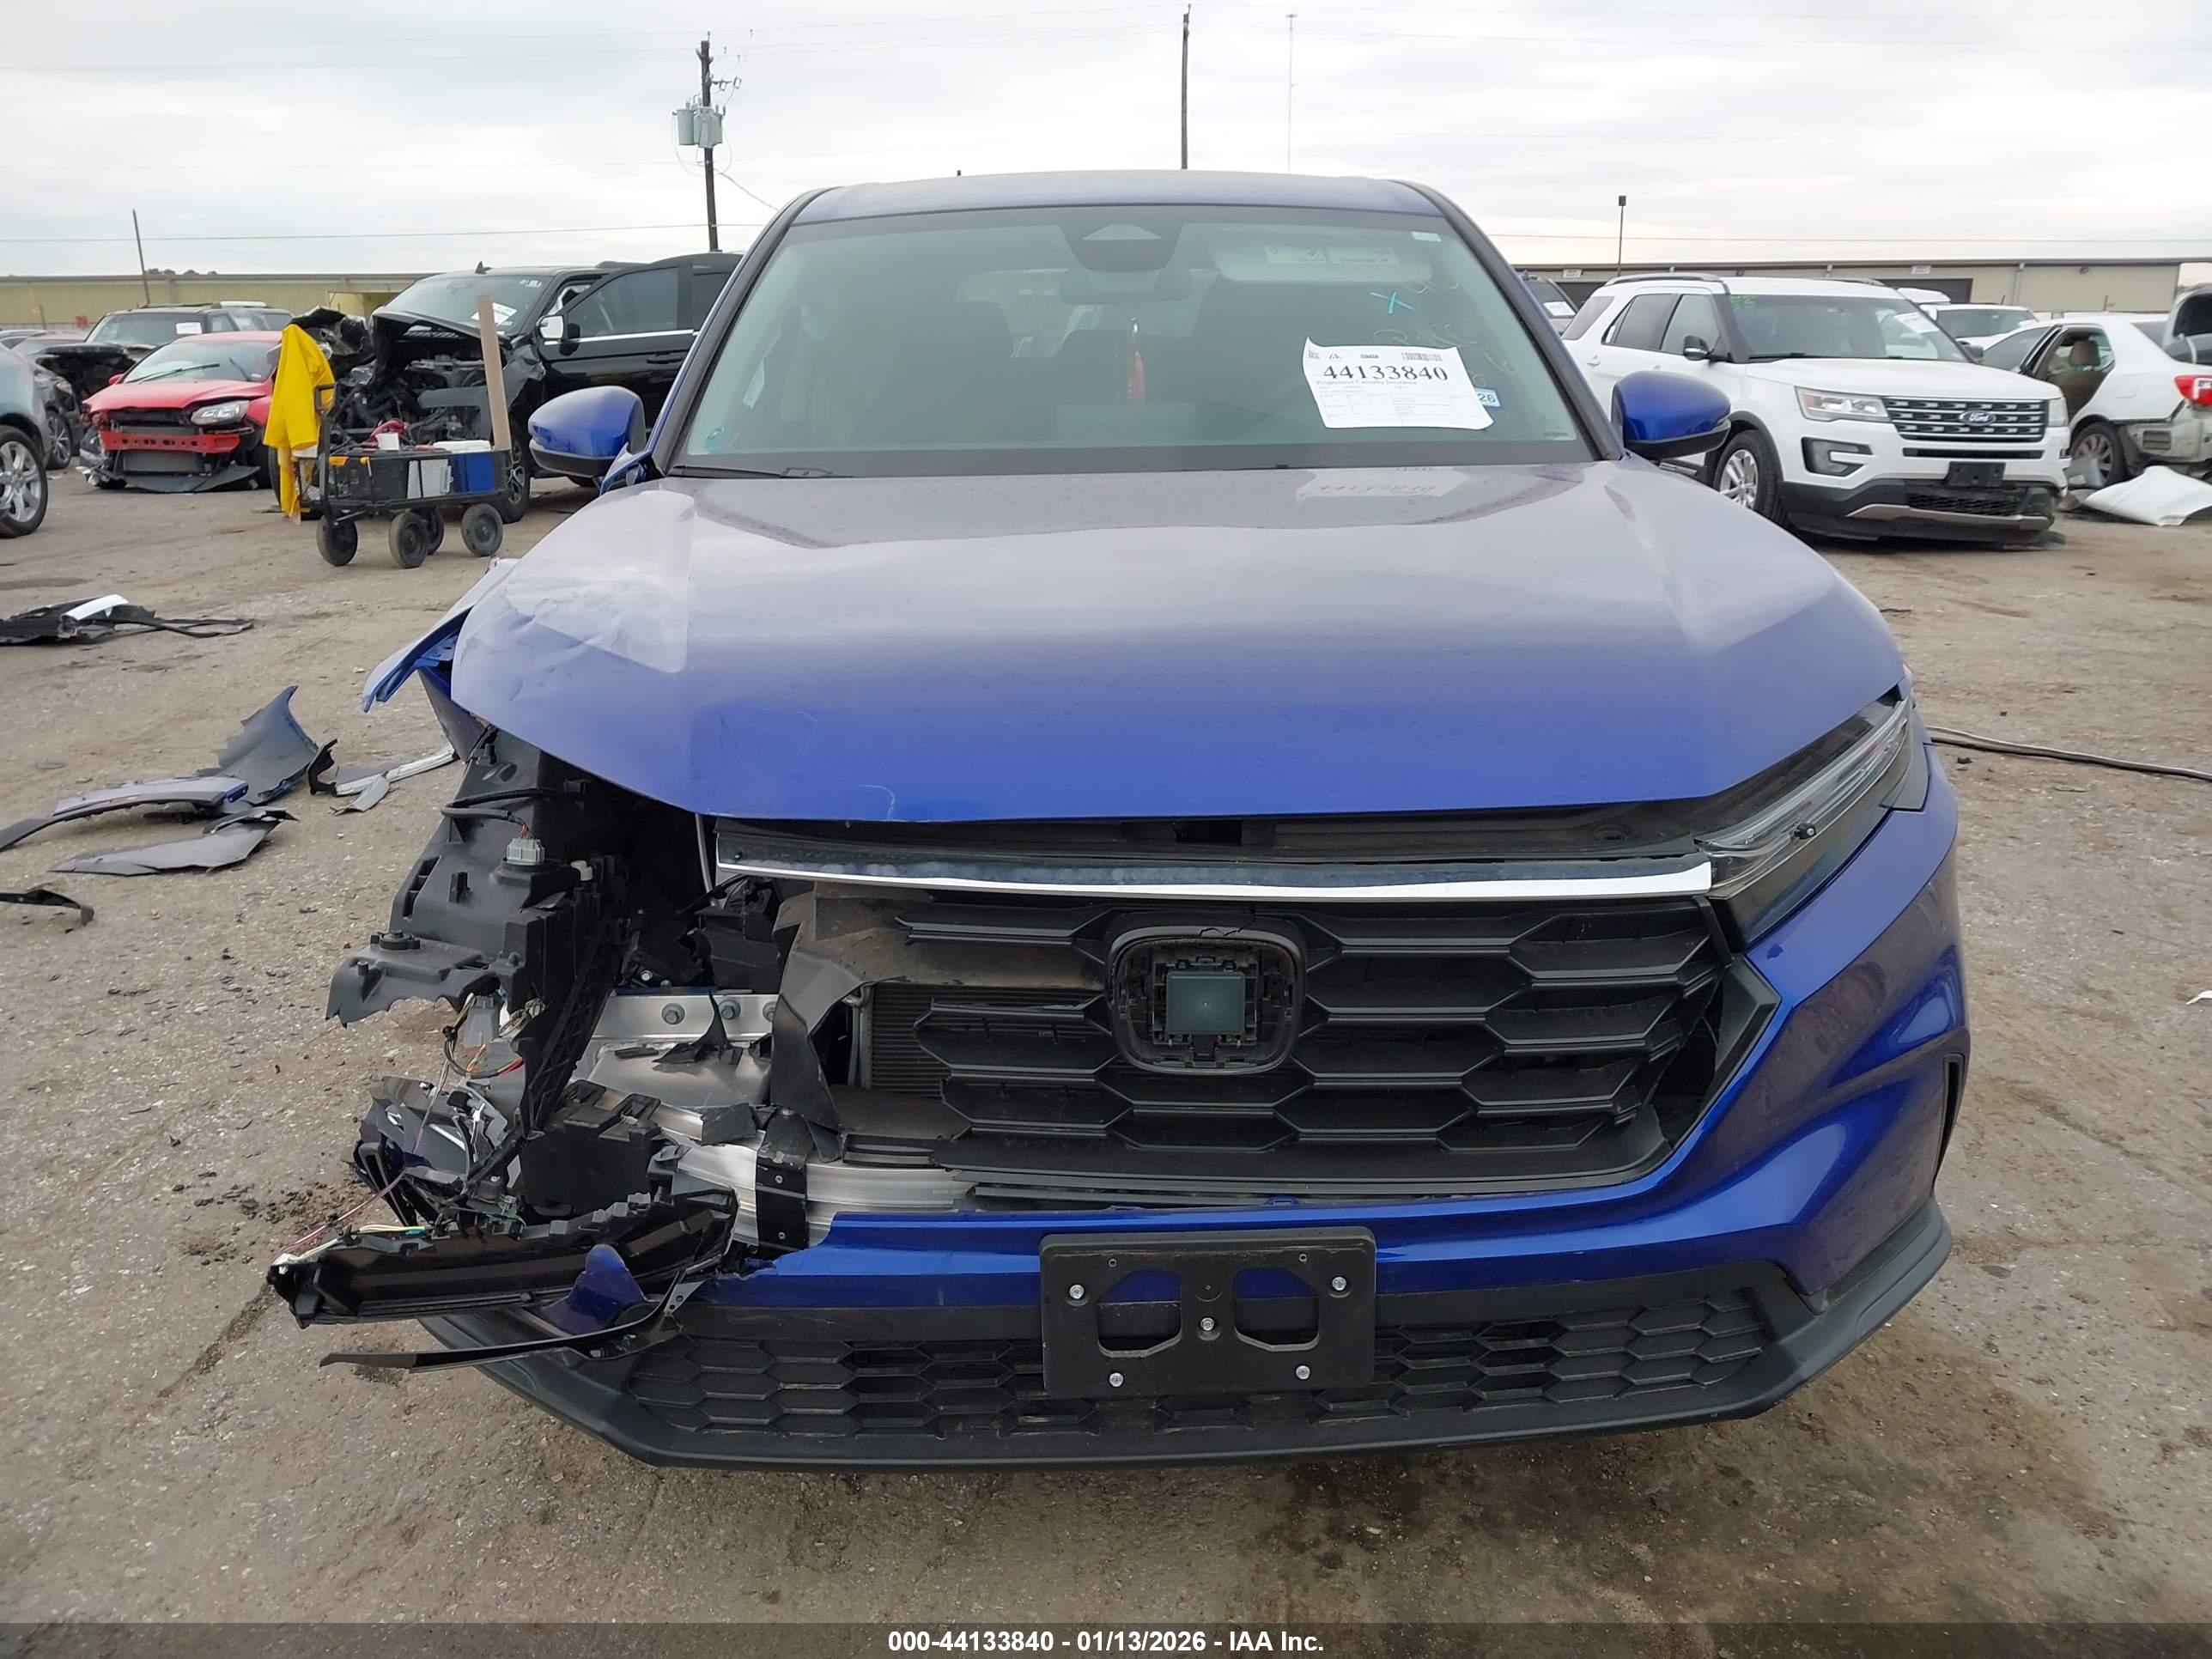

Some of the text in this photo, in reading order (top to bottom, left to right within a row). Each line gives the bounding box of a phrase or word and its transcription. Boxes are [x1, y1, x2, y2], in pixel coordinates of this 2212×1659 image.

[1323, 365, 1449, 381] 44133840
[1477, 392, 1496, 404] 26
[1968, 412, 1990, 422] Ford
